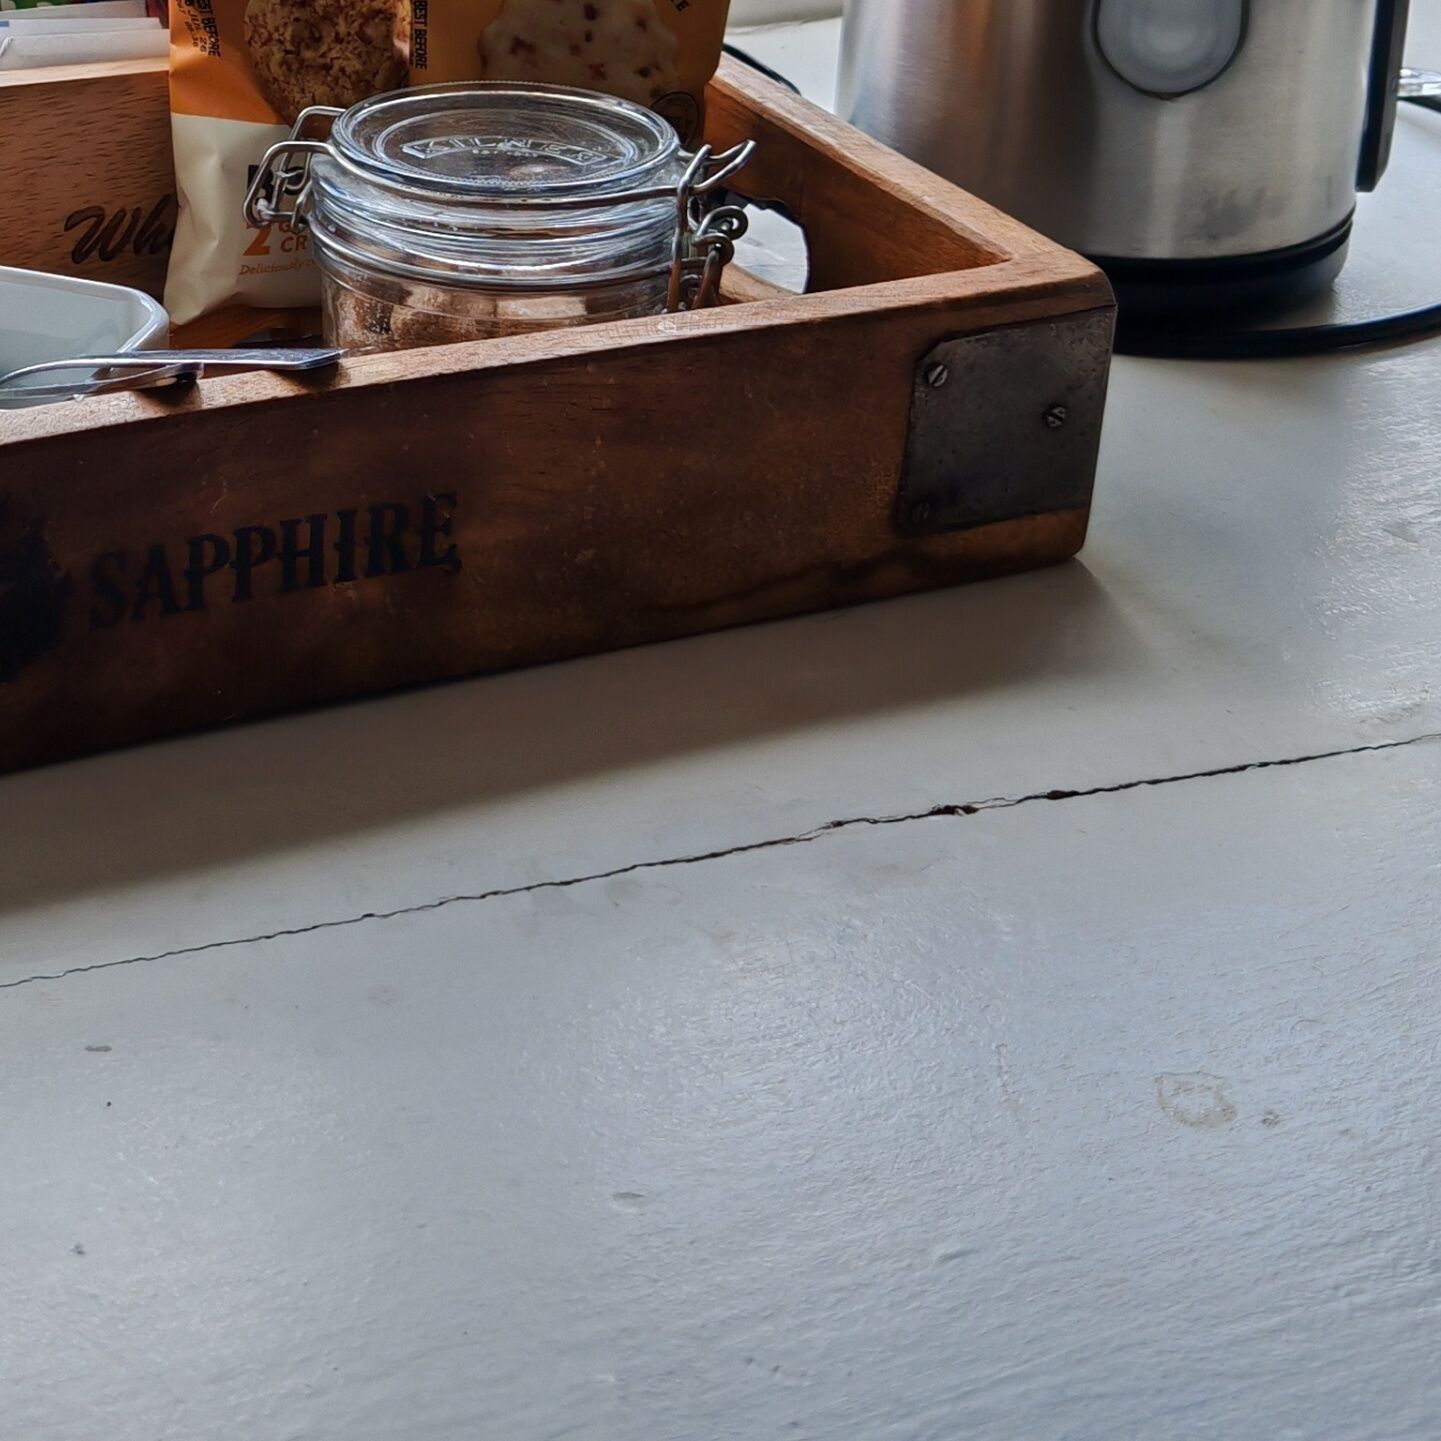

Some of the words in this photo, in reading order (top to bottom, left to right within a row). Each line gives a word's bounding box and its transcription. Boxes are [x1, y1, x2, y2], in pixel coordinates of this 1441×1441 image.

[413, 0, 428, 27] BEST
[201, 18, 221, 58] BEFORE
[414, 28, 428, 70] BEFORE
[243, 221, 271, 256] 2
[238, 260, 304, 276] Deliciously
[86, 491, 462, 631] SAPPHIRE
